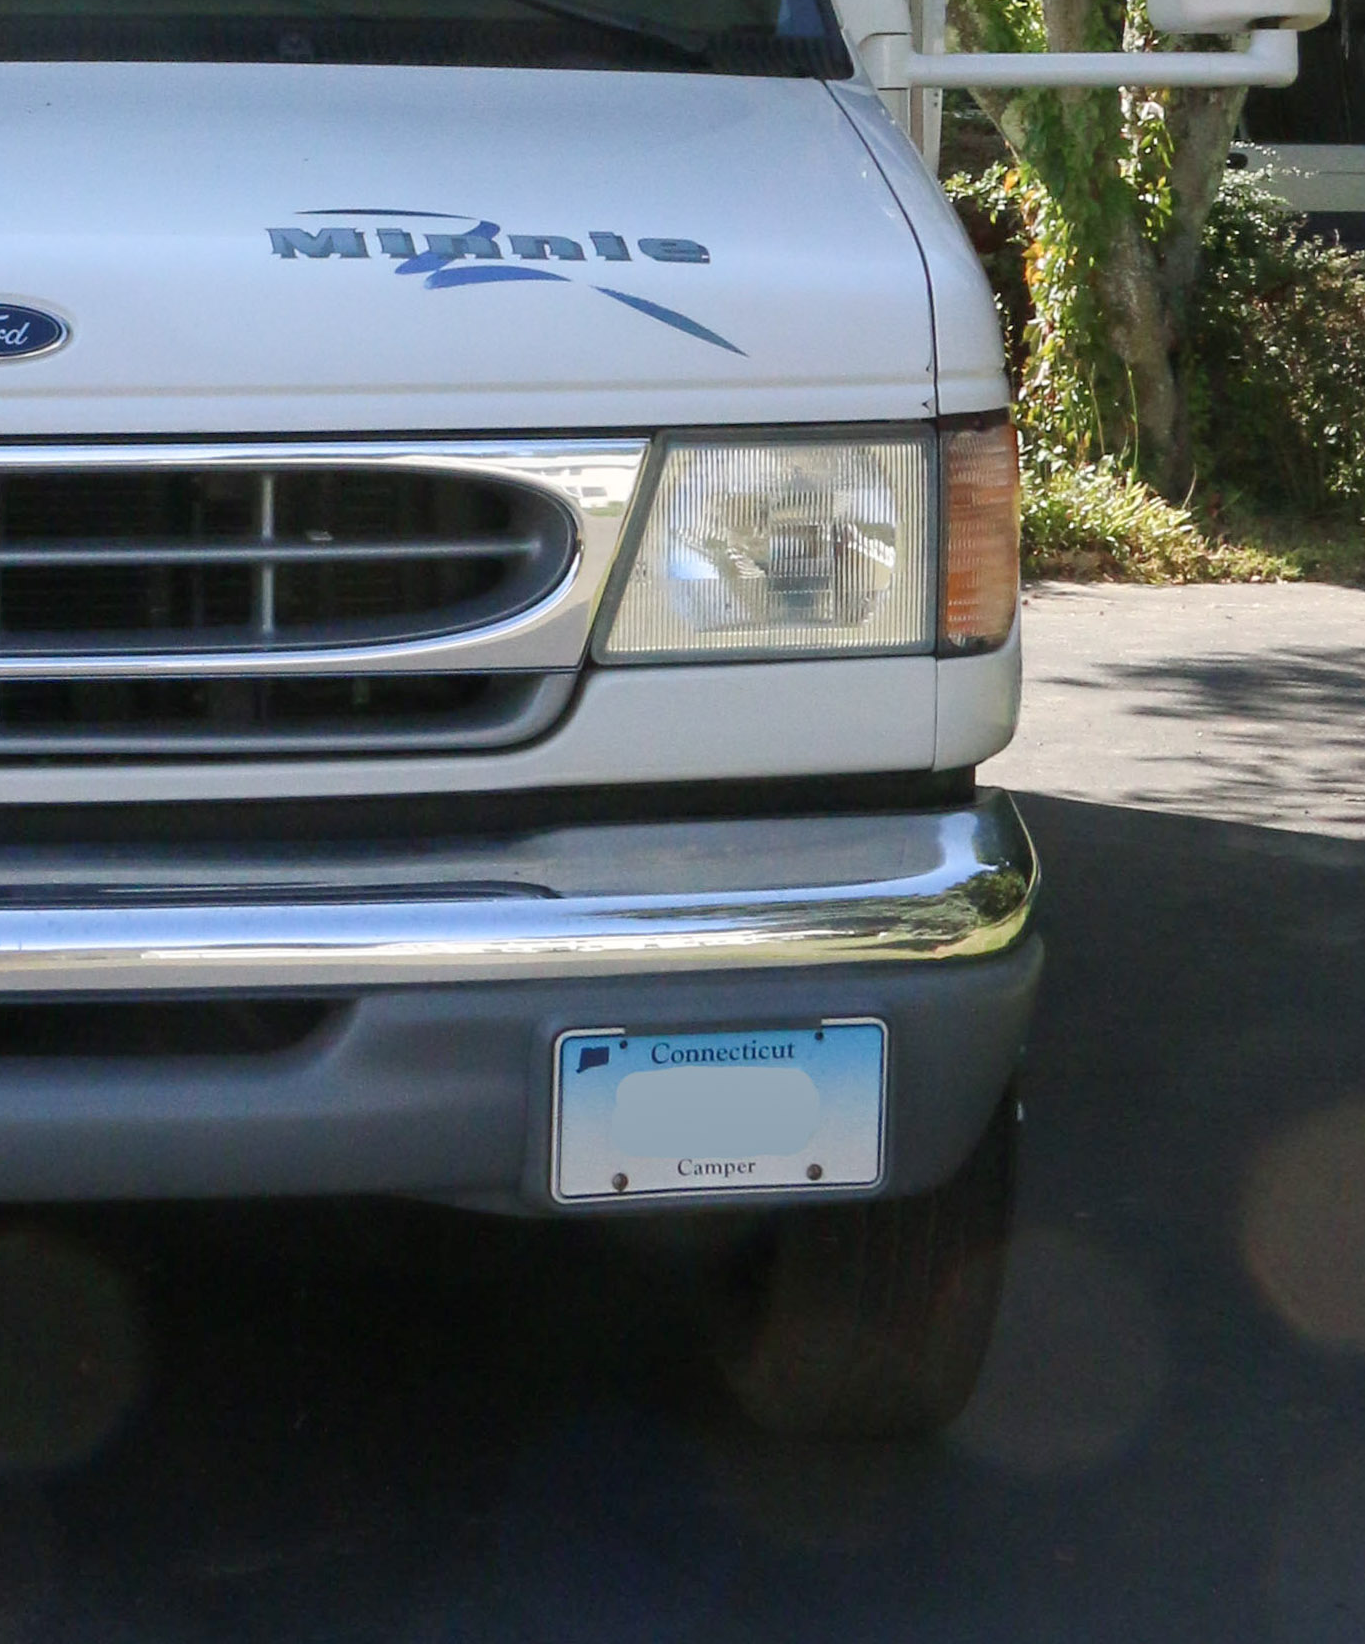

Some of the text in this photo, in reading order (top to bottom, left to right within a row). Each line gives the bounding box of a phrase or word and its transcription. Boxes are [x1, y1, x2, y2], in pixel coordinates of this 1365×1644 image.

[266, 227, 711, 264] Minnie
[651, 1040, 795, 1065] Connecticut
[677, 1158, 756, 1178] Camper
